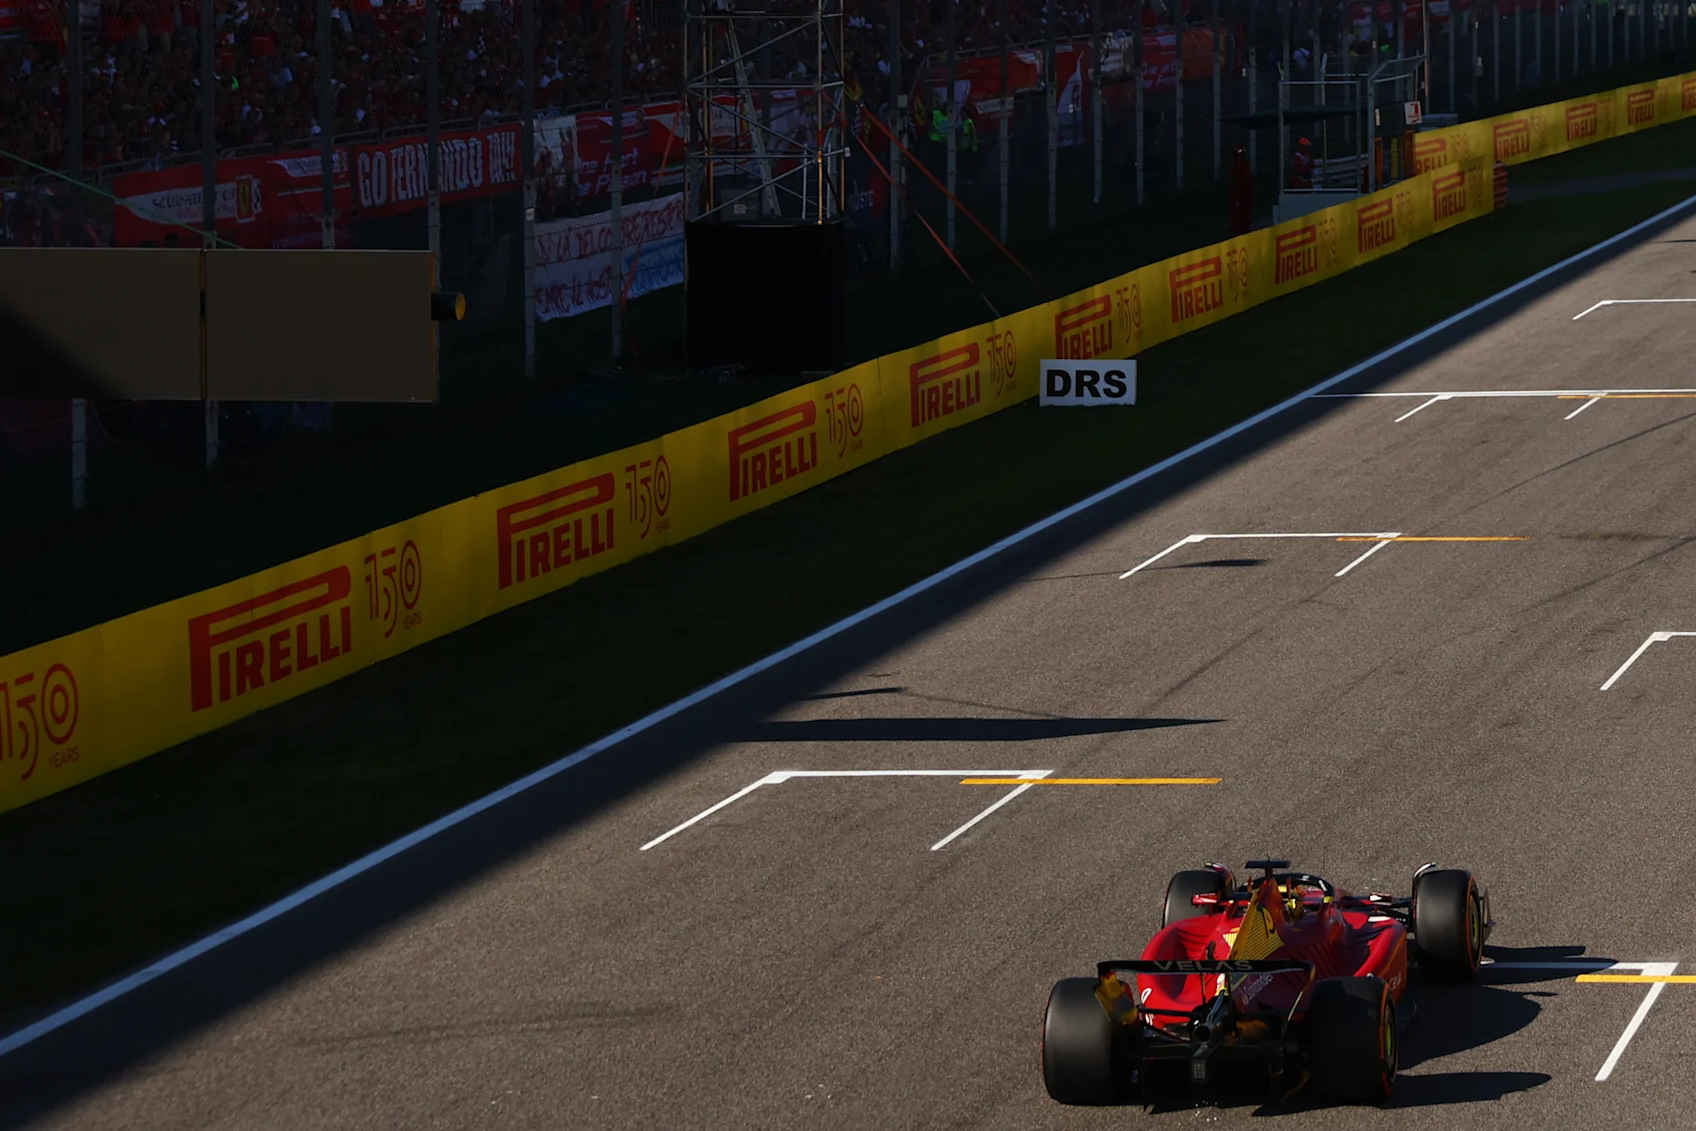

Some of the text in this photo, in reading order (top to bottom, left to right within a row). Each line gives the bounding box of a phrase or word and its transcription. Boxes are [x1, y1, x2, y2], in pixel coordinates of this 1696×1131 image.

[1566, 101, 1597, 142] PIRELLI
[1628, 88, 1655, 125] PIRELLI
[1493, 118, 1530, 161] PIRELLI
[358, 150, 387, 208] GO
[1432, 171, 1466, 222] PIRELLI
[1357, 197, 1395, 254] PIRELLI
[1275, 224, 1318, 285] PIRELLI
[1169, 256, 1223, 324] PIRELLI
[1055, 294, 1112, 360] PIRELLI
[910, 342, 981, 427] PIRELLI
[1046, 369, 1127, 399] DRS
[727, 399, 817, 502] PIRELLI
[497, 472, 615, 590] PIRELLI
[188, 565, 352, 713] PIRELLI
[48, 745, 79, 769] YEARS
[1154, 961, 1253, 971] VELAS
[1246, 972, 1275, 1002] Santander
